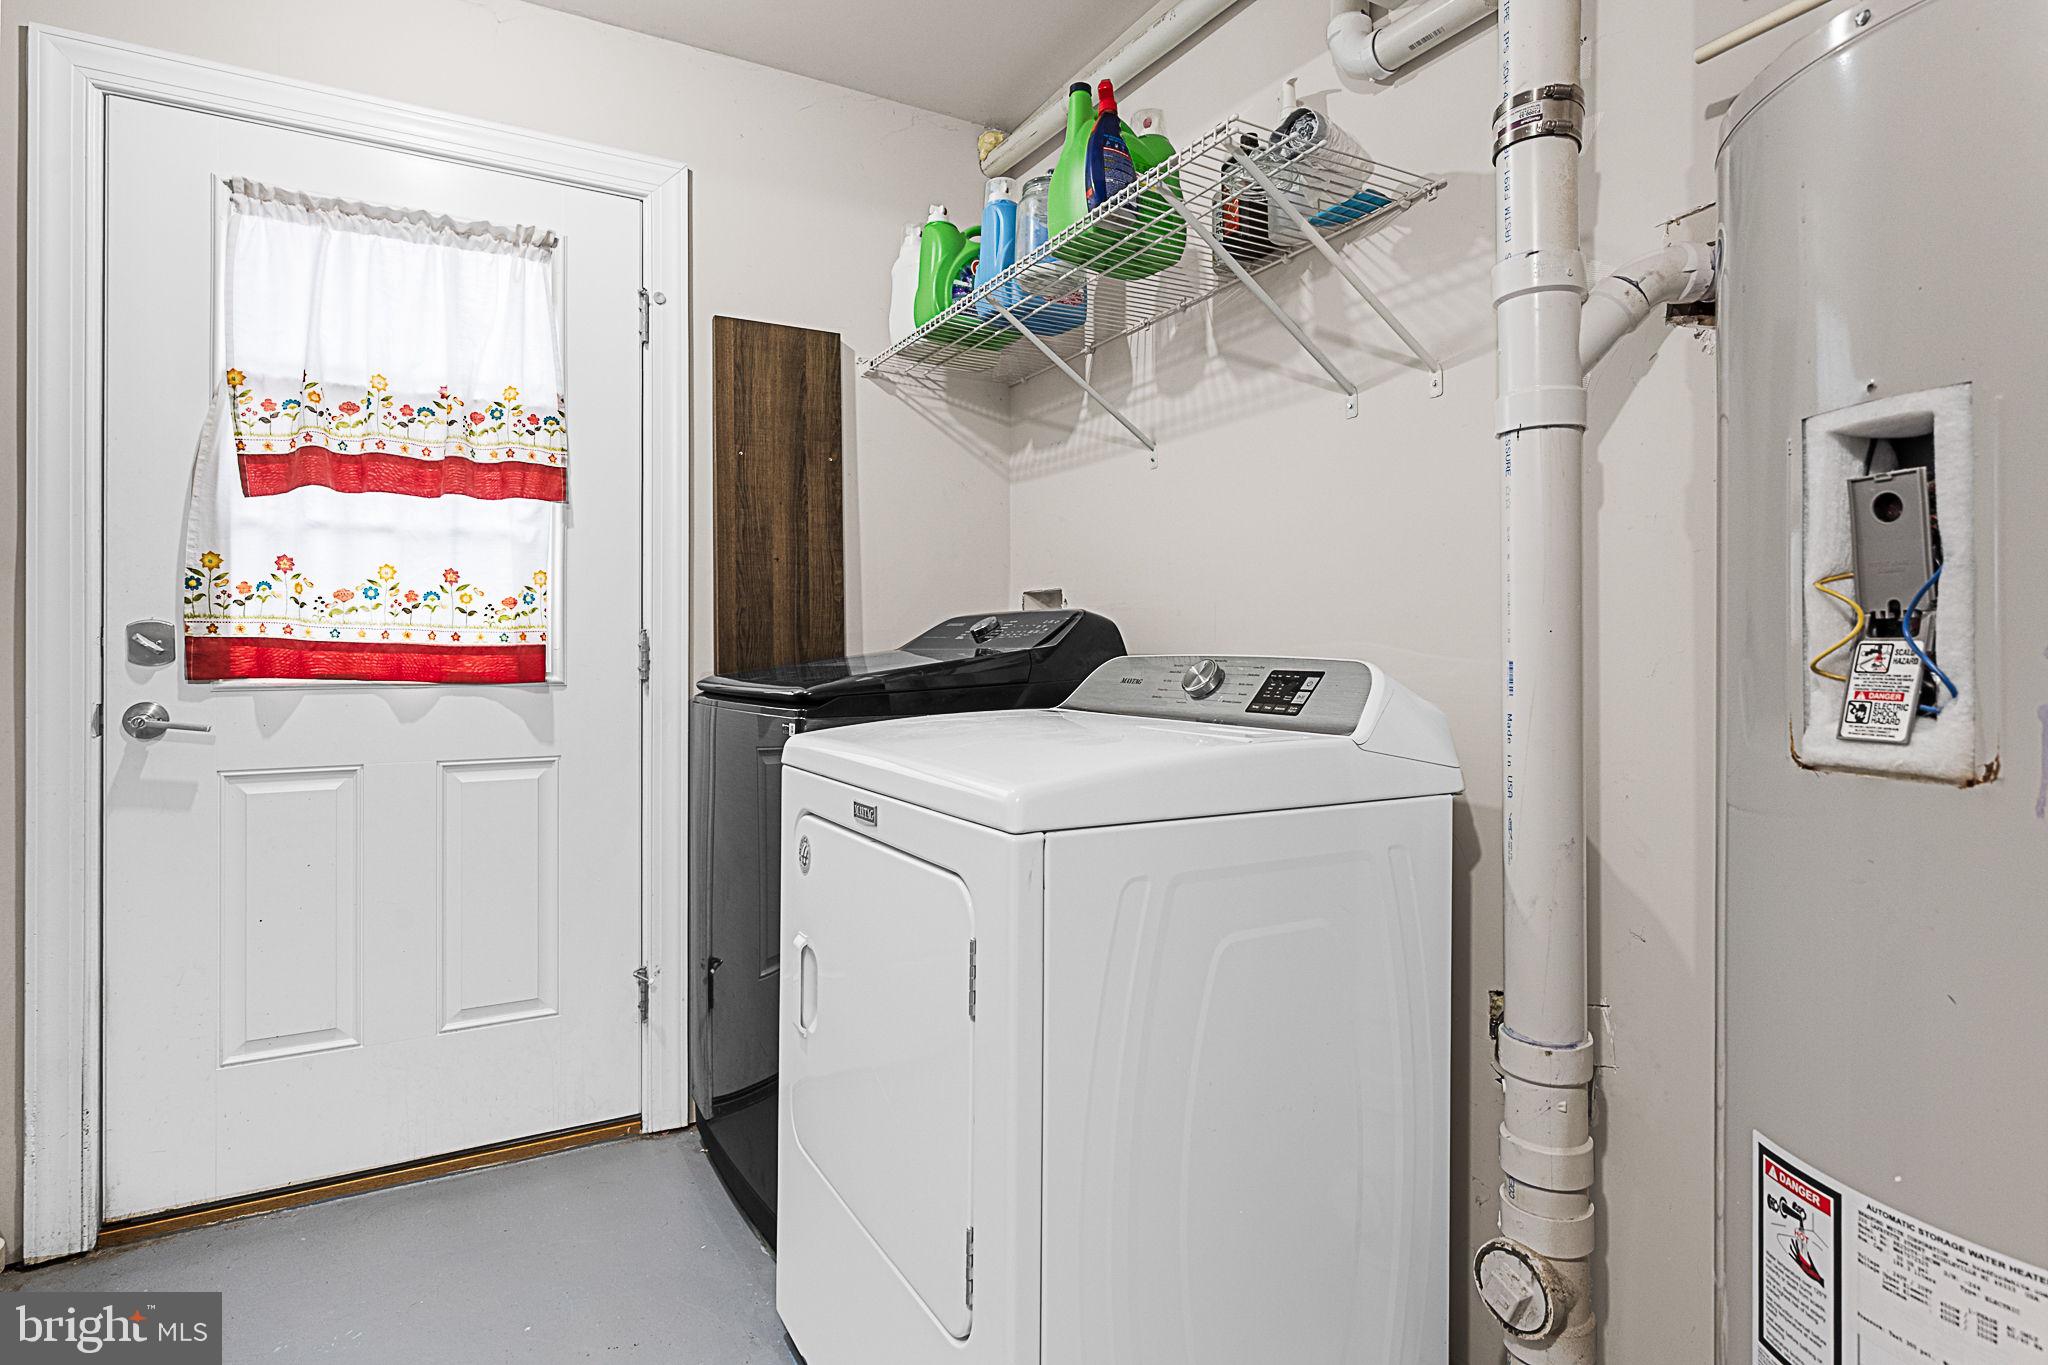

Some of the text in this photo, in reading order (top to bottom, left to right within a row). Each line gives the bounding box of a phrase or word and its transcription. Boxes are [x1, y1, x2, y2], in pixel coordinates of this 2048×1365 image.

[1892, 657, 1919, 665] HAZARD
[1868, 692, 1902, 700] DANGER
[1873, 702, 1910, 712] ELECTRIC
[1872, 709, 1898, 718] SHOCK
[1870, 716, 1901, 725] HAZARD
[1779, 1171, 1821, 1207] DANGER
[1794, 1229, 1809, 1243] HOT
[1866, 1203, 1916, 1232] AUTOMATIC
[1918, 1228, 1966, 1254] STORAGE
[1968, 1249, 2006, 1270] WATER
